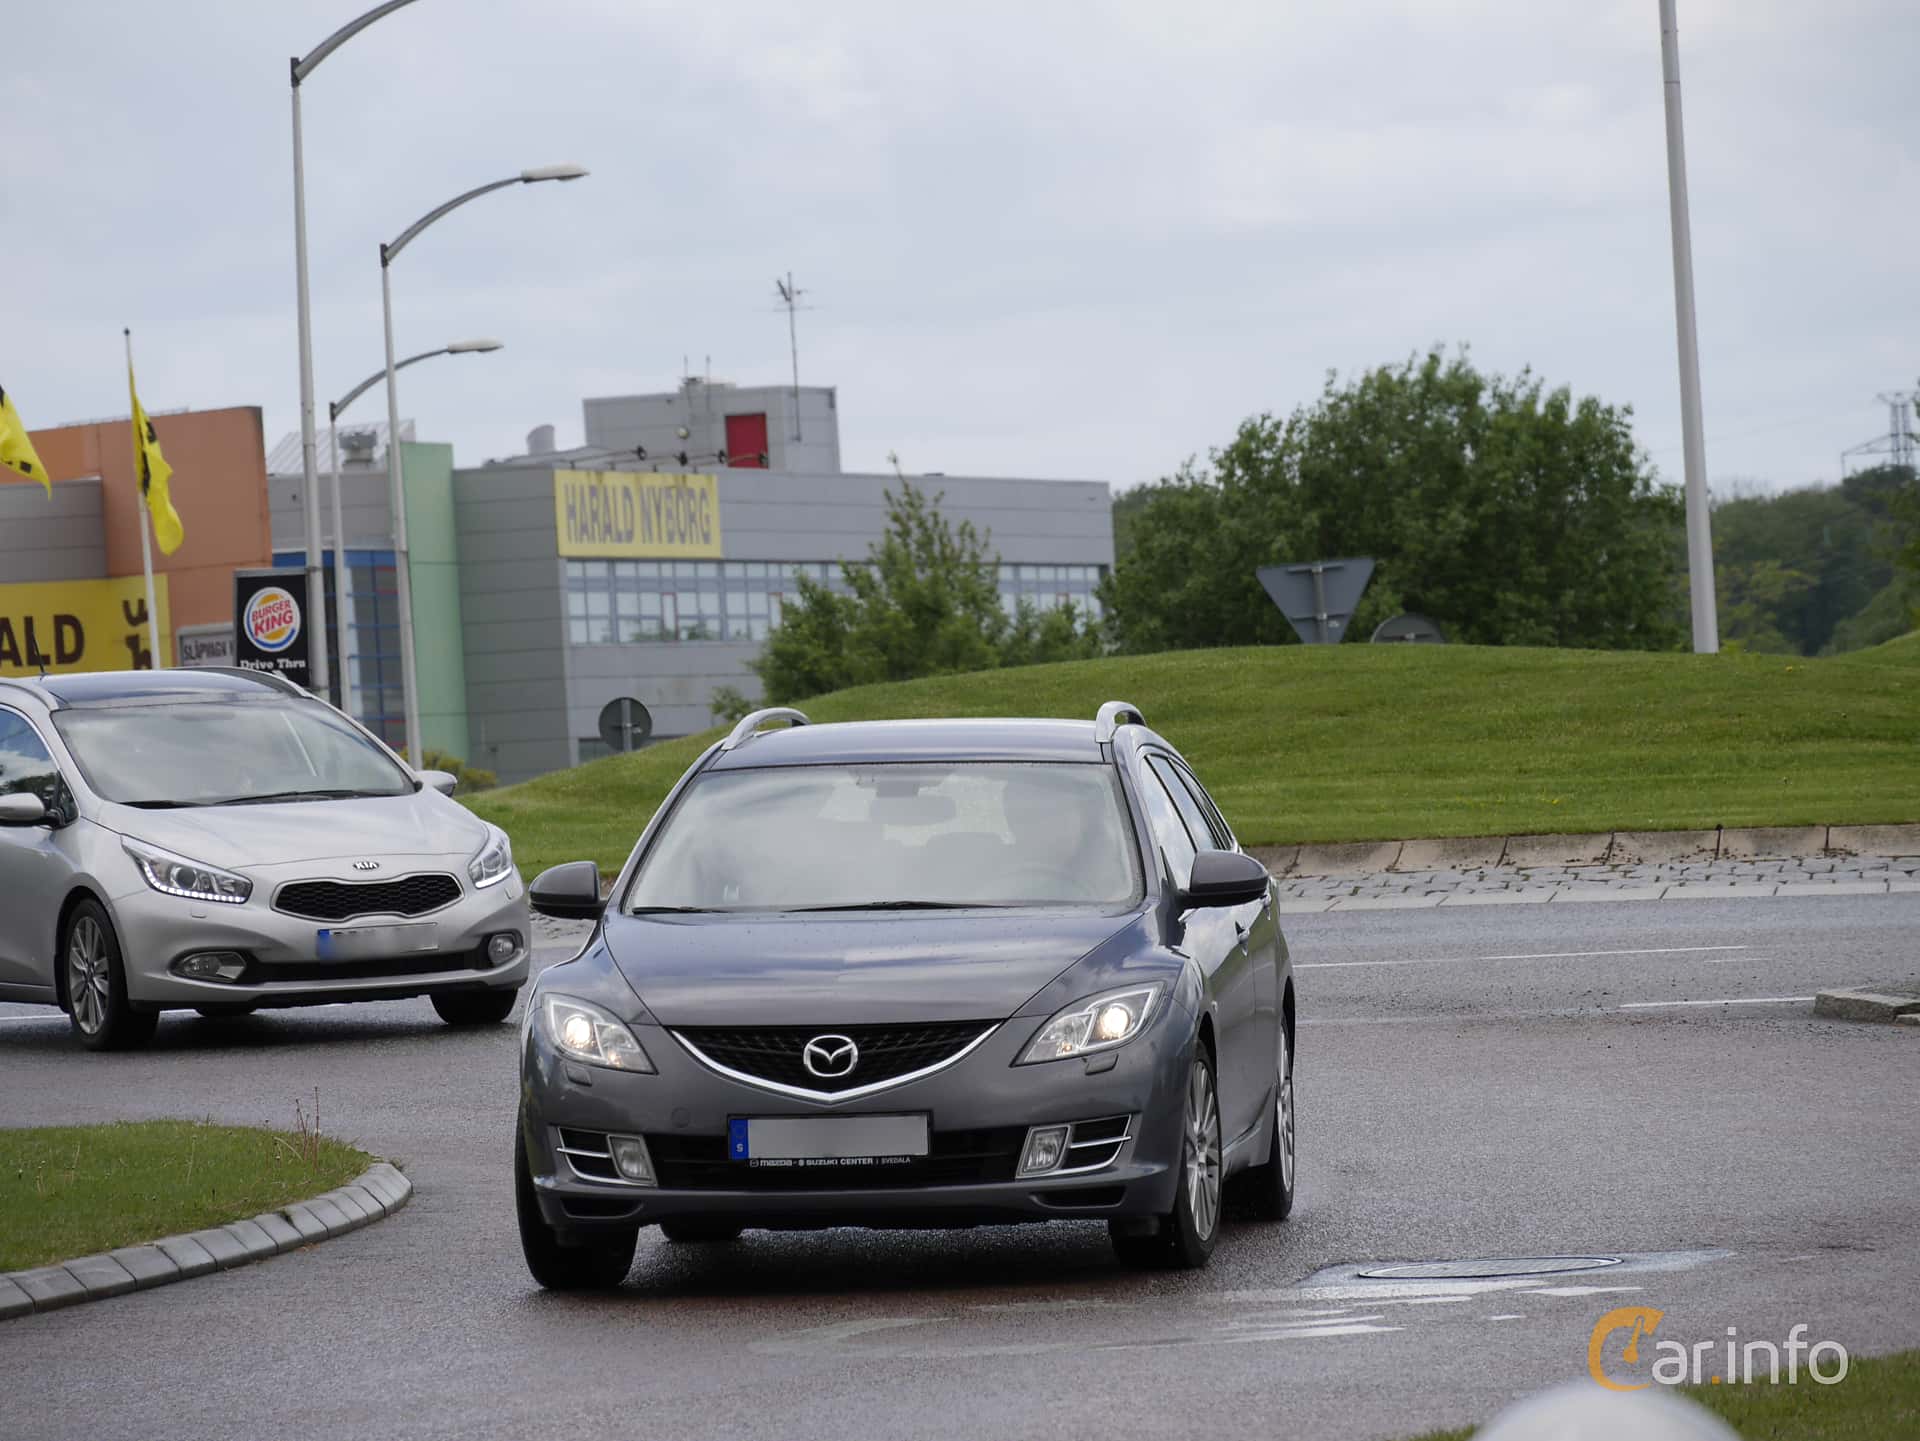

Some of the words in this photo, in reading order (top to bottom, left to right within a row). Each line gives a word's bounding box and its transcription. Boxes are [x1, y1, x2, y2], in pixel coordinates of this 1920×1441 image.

[563, 483, 635, 544] HARALD
[639, 485, 712, 545] NYBORG
[251, 599, 291, 622] BURGER
[253, 609, 293, 637] KING
[0, 613, 85, 667] ALD
[240, 659, 274, 670] Drive
[276, 658, 306, 669] Thru
[735, 1142, 744, 1153] S
[805, 1158, 838, 1166] SUZUKI
[840, 1157, 873, 1166] CENTER
